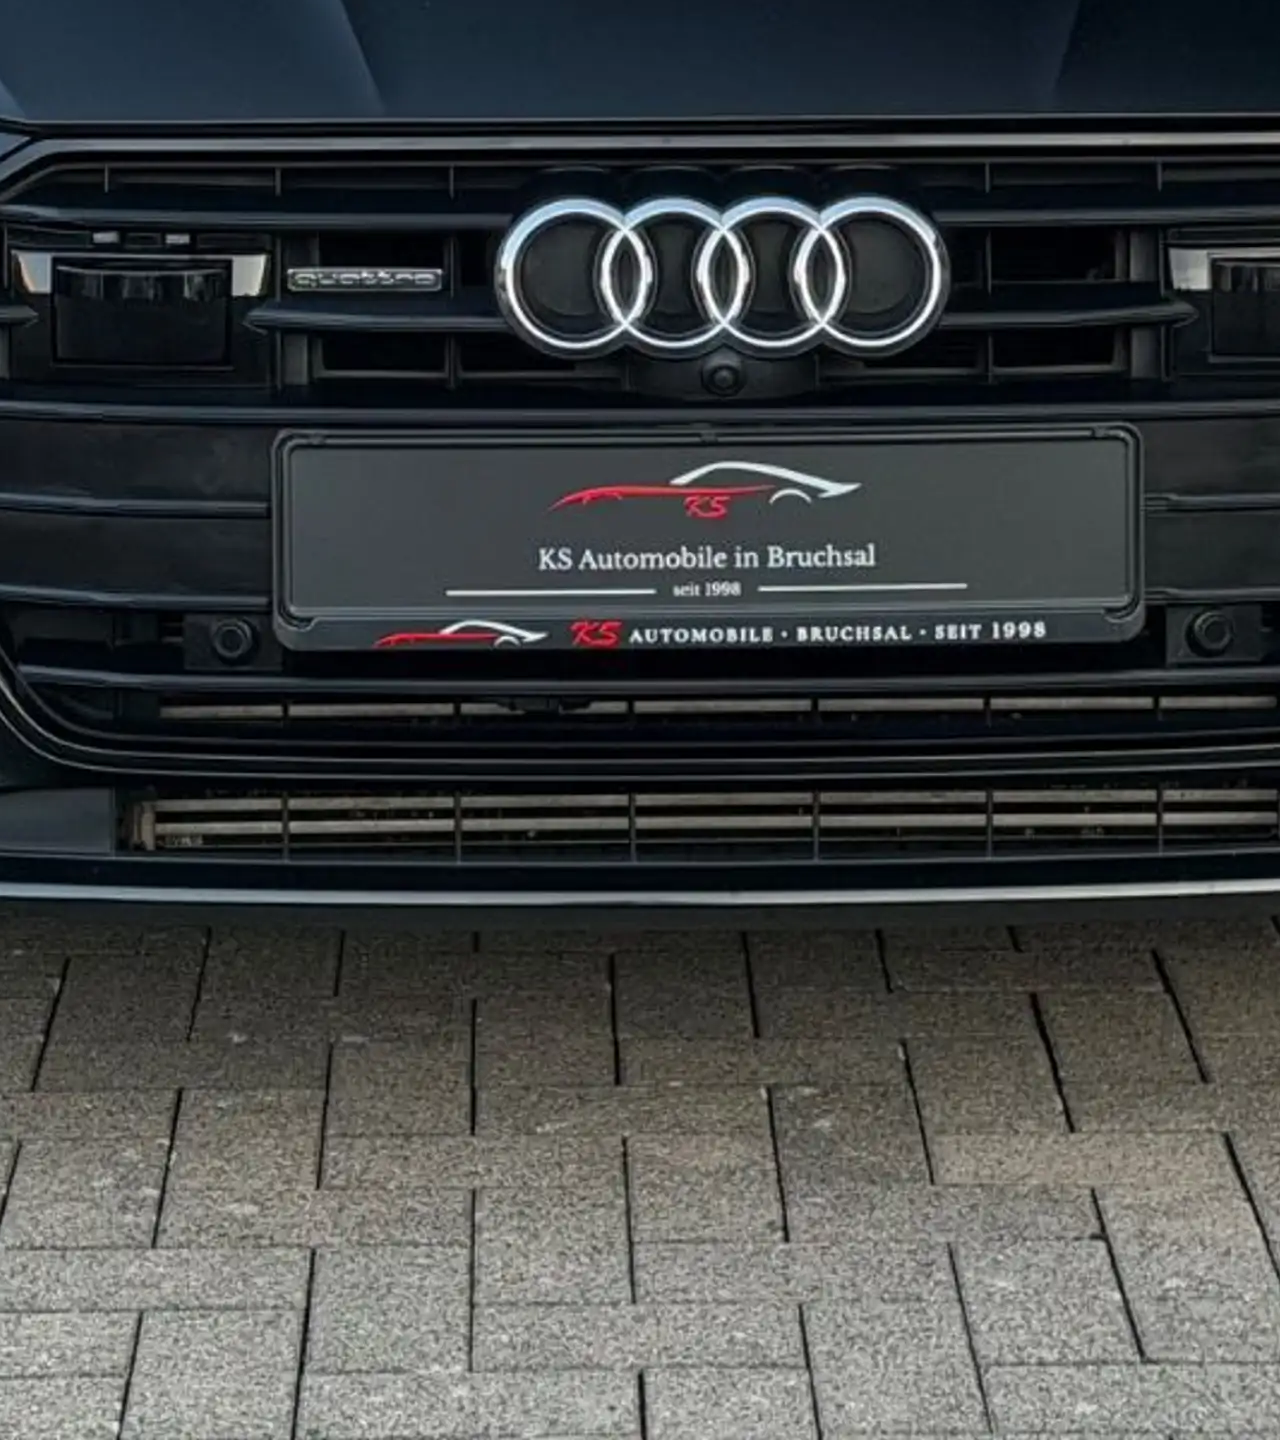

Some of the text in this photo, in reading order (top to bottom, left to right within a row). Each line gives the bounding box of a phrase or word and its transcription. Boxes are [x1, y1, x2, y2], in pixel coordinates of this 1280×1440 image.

[538, 543, 876, 571] KS Automobile in Bruchsal
[672, 581, 742, 597] seit 1998
[569, 620, 1047, 647] KS AUTOMOBILE BRUCHSAL SEIT 1998
